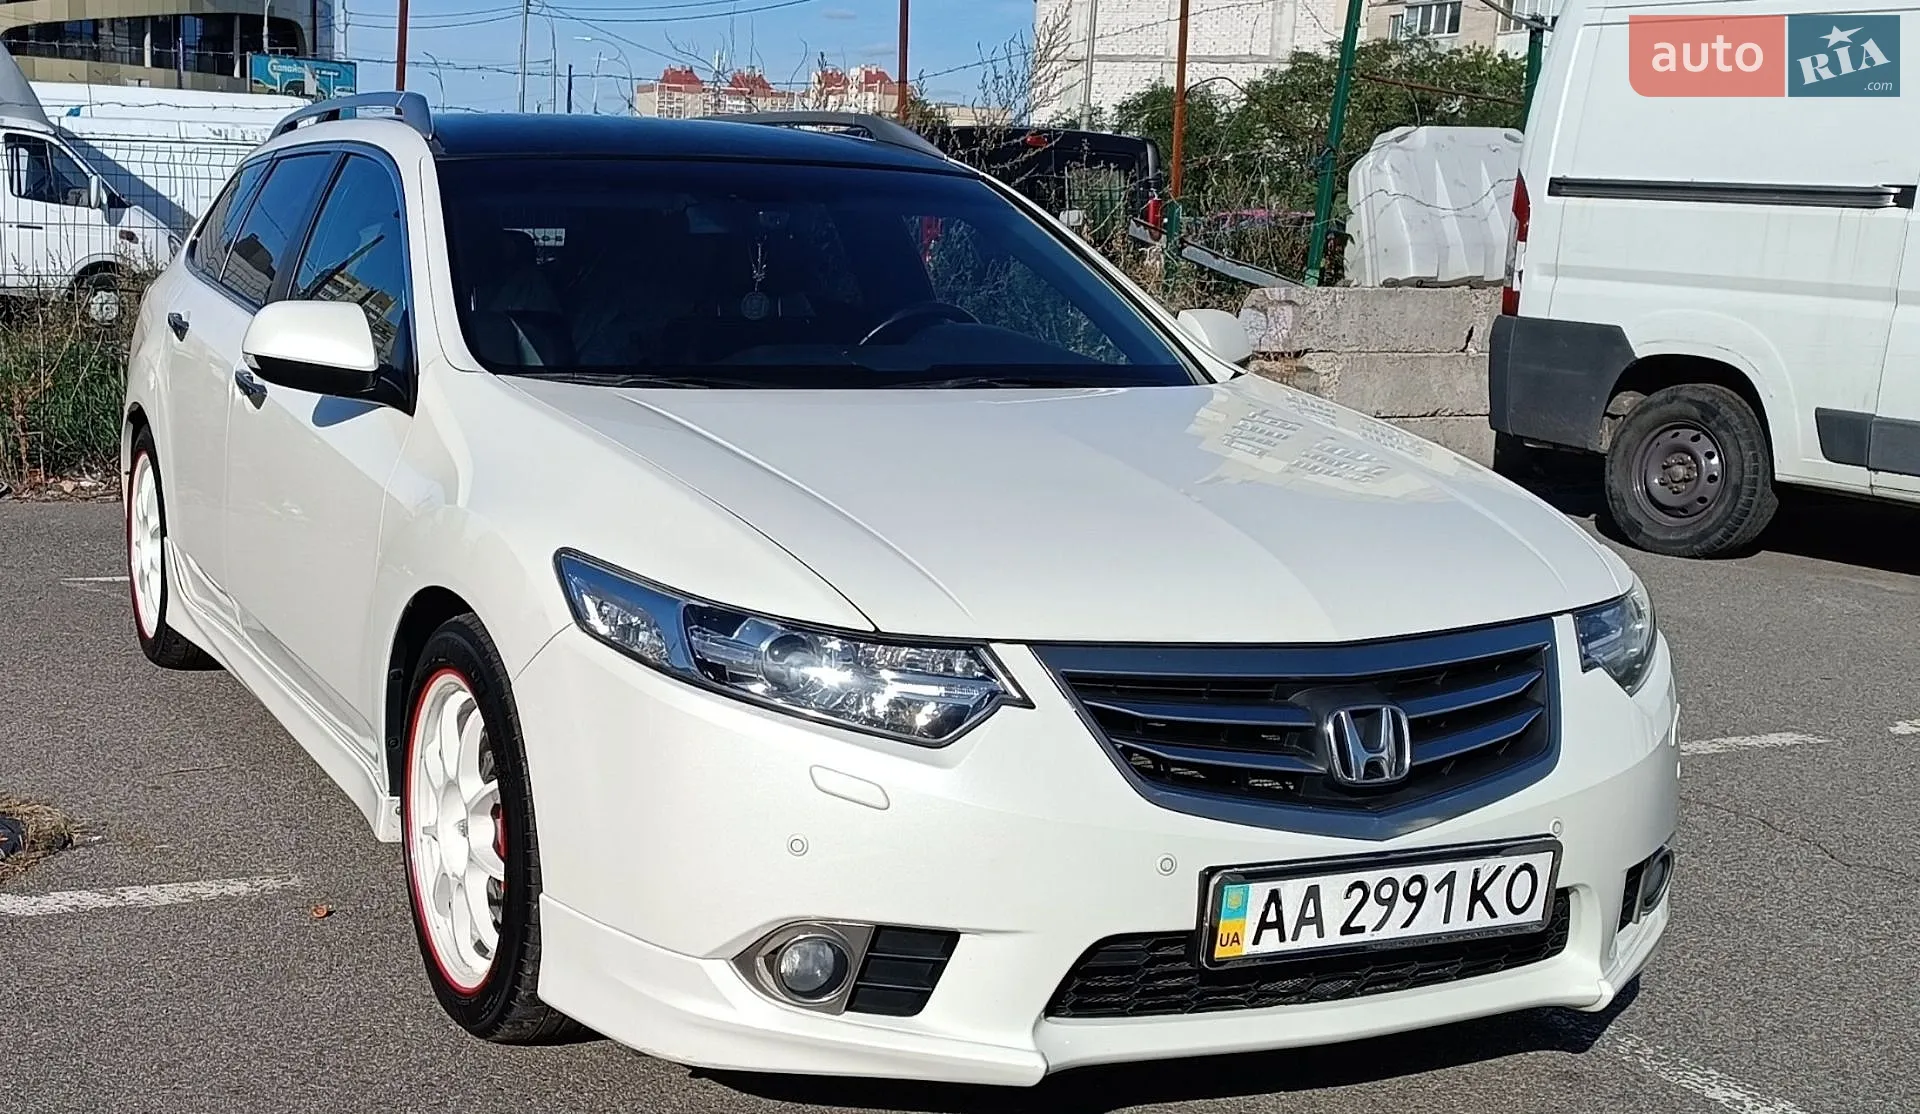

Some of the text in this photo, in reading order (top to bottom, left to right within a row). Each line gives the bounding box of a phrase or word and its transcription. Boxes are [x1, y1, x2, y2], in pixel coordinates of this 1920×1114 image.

[1251, 862, 1539, 946] AA 2991 KO
[1219, 931, 1241, 947] UA
